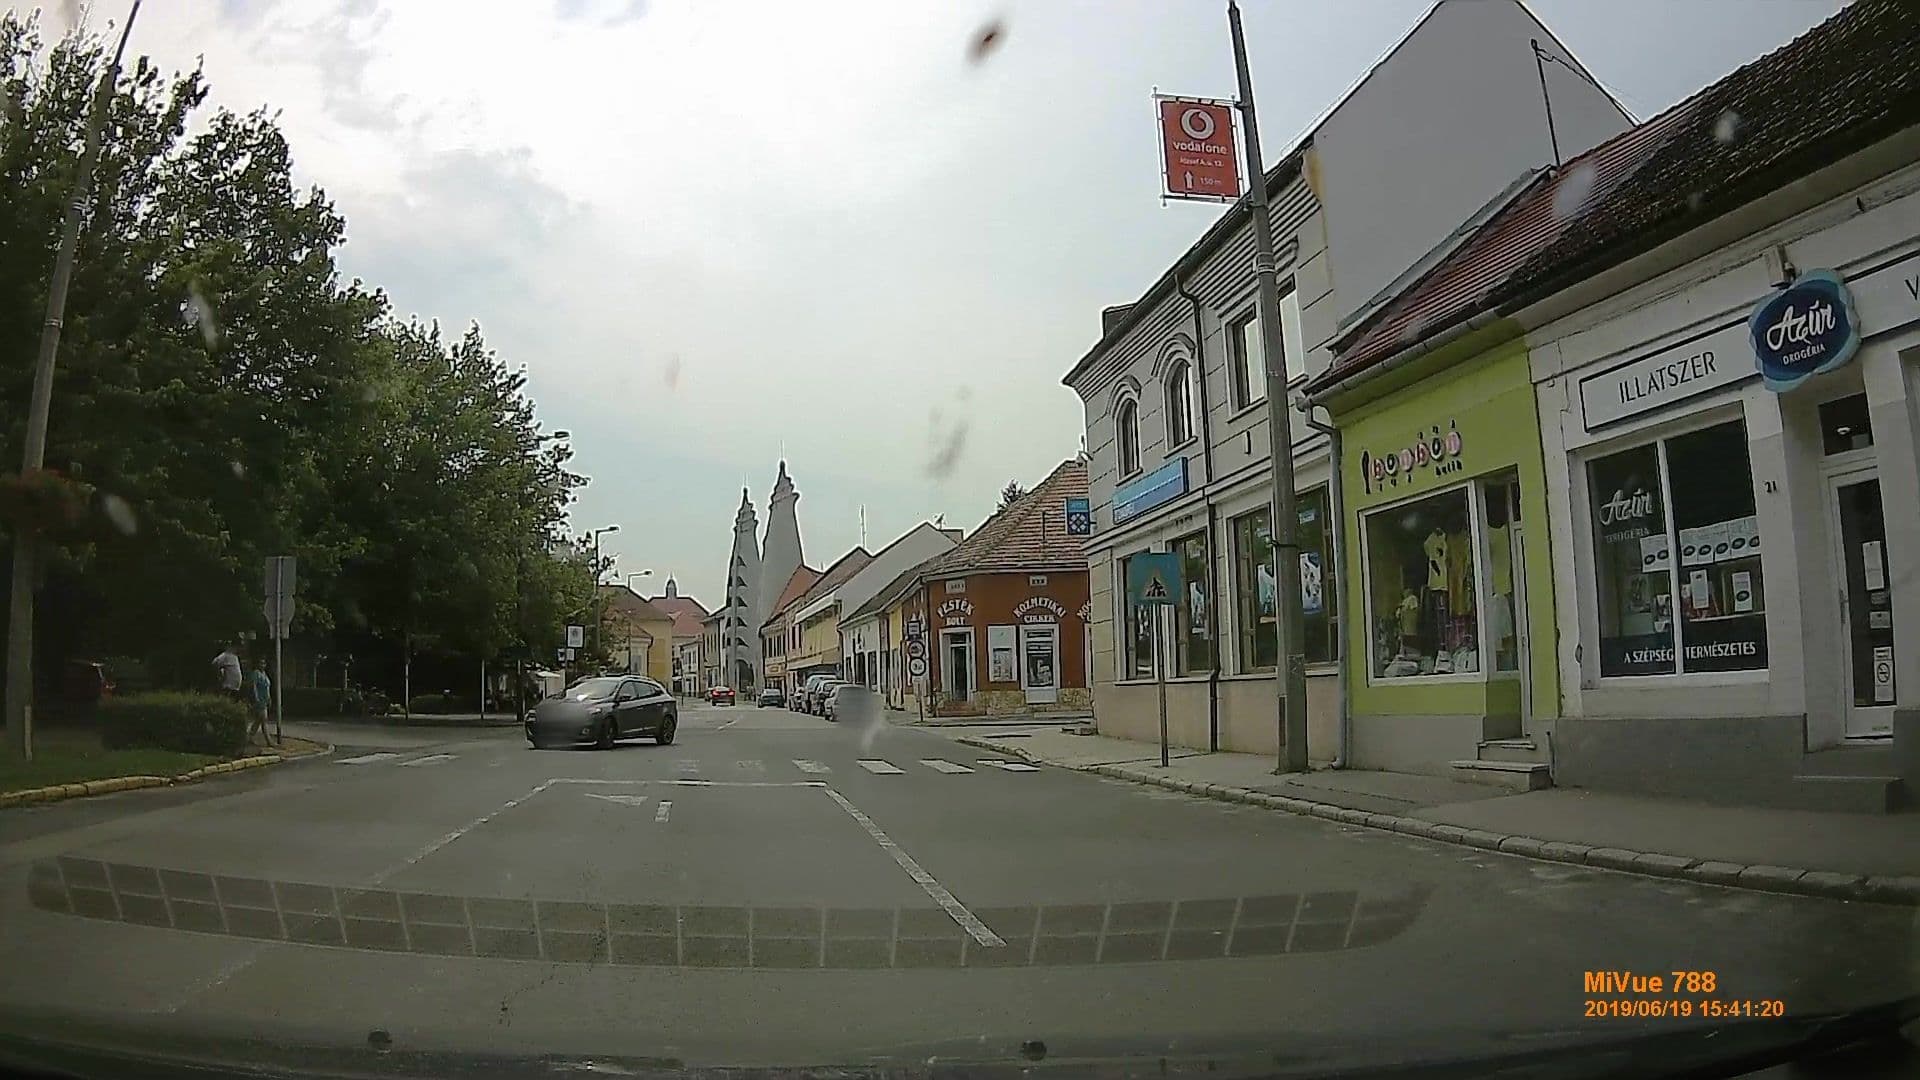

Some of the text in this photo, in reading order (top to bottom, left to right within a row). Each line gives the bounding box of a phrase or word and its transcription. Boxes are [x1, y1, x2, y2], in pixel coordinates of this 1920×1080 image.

[1173, 140, 1227, 155] vodafone
[1200, 177, 1214, 186] 150
[1619, 351, 1716, 404] ILLATSZER
[1624, 640, 1756, 664] A SZÉPSÉG TERMÉSZETES
